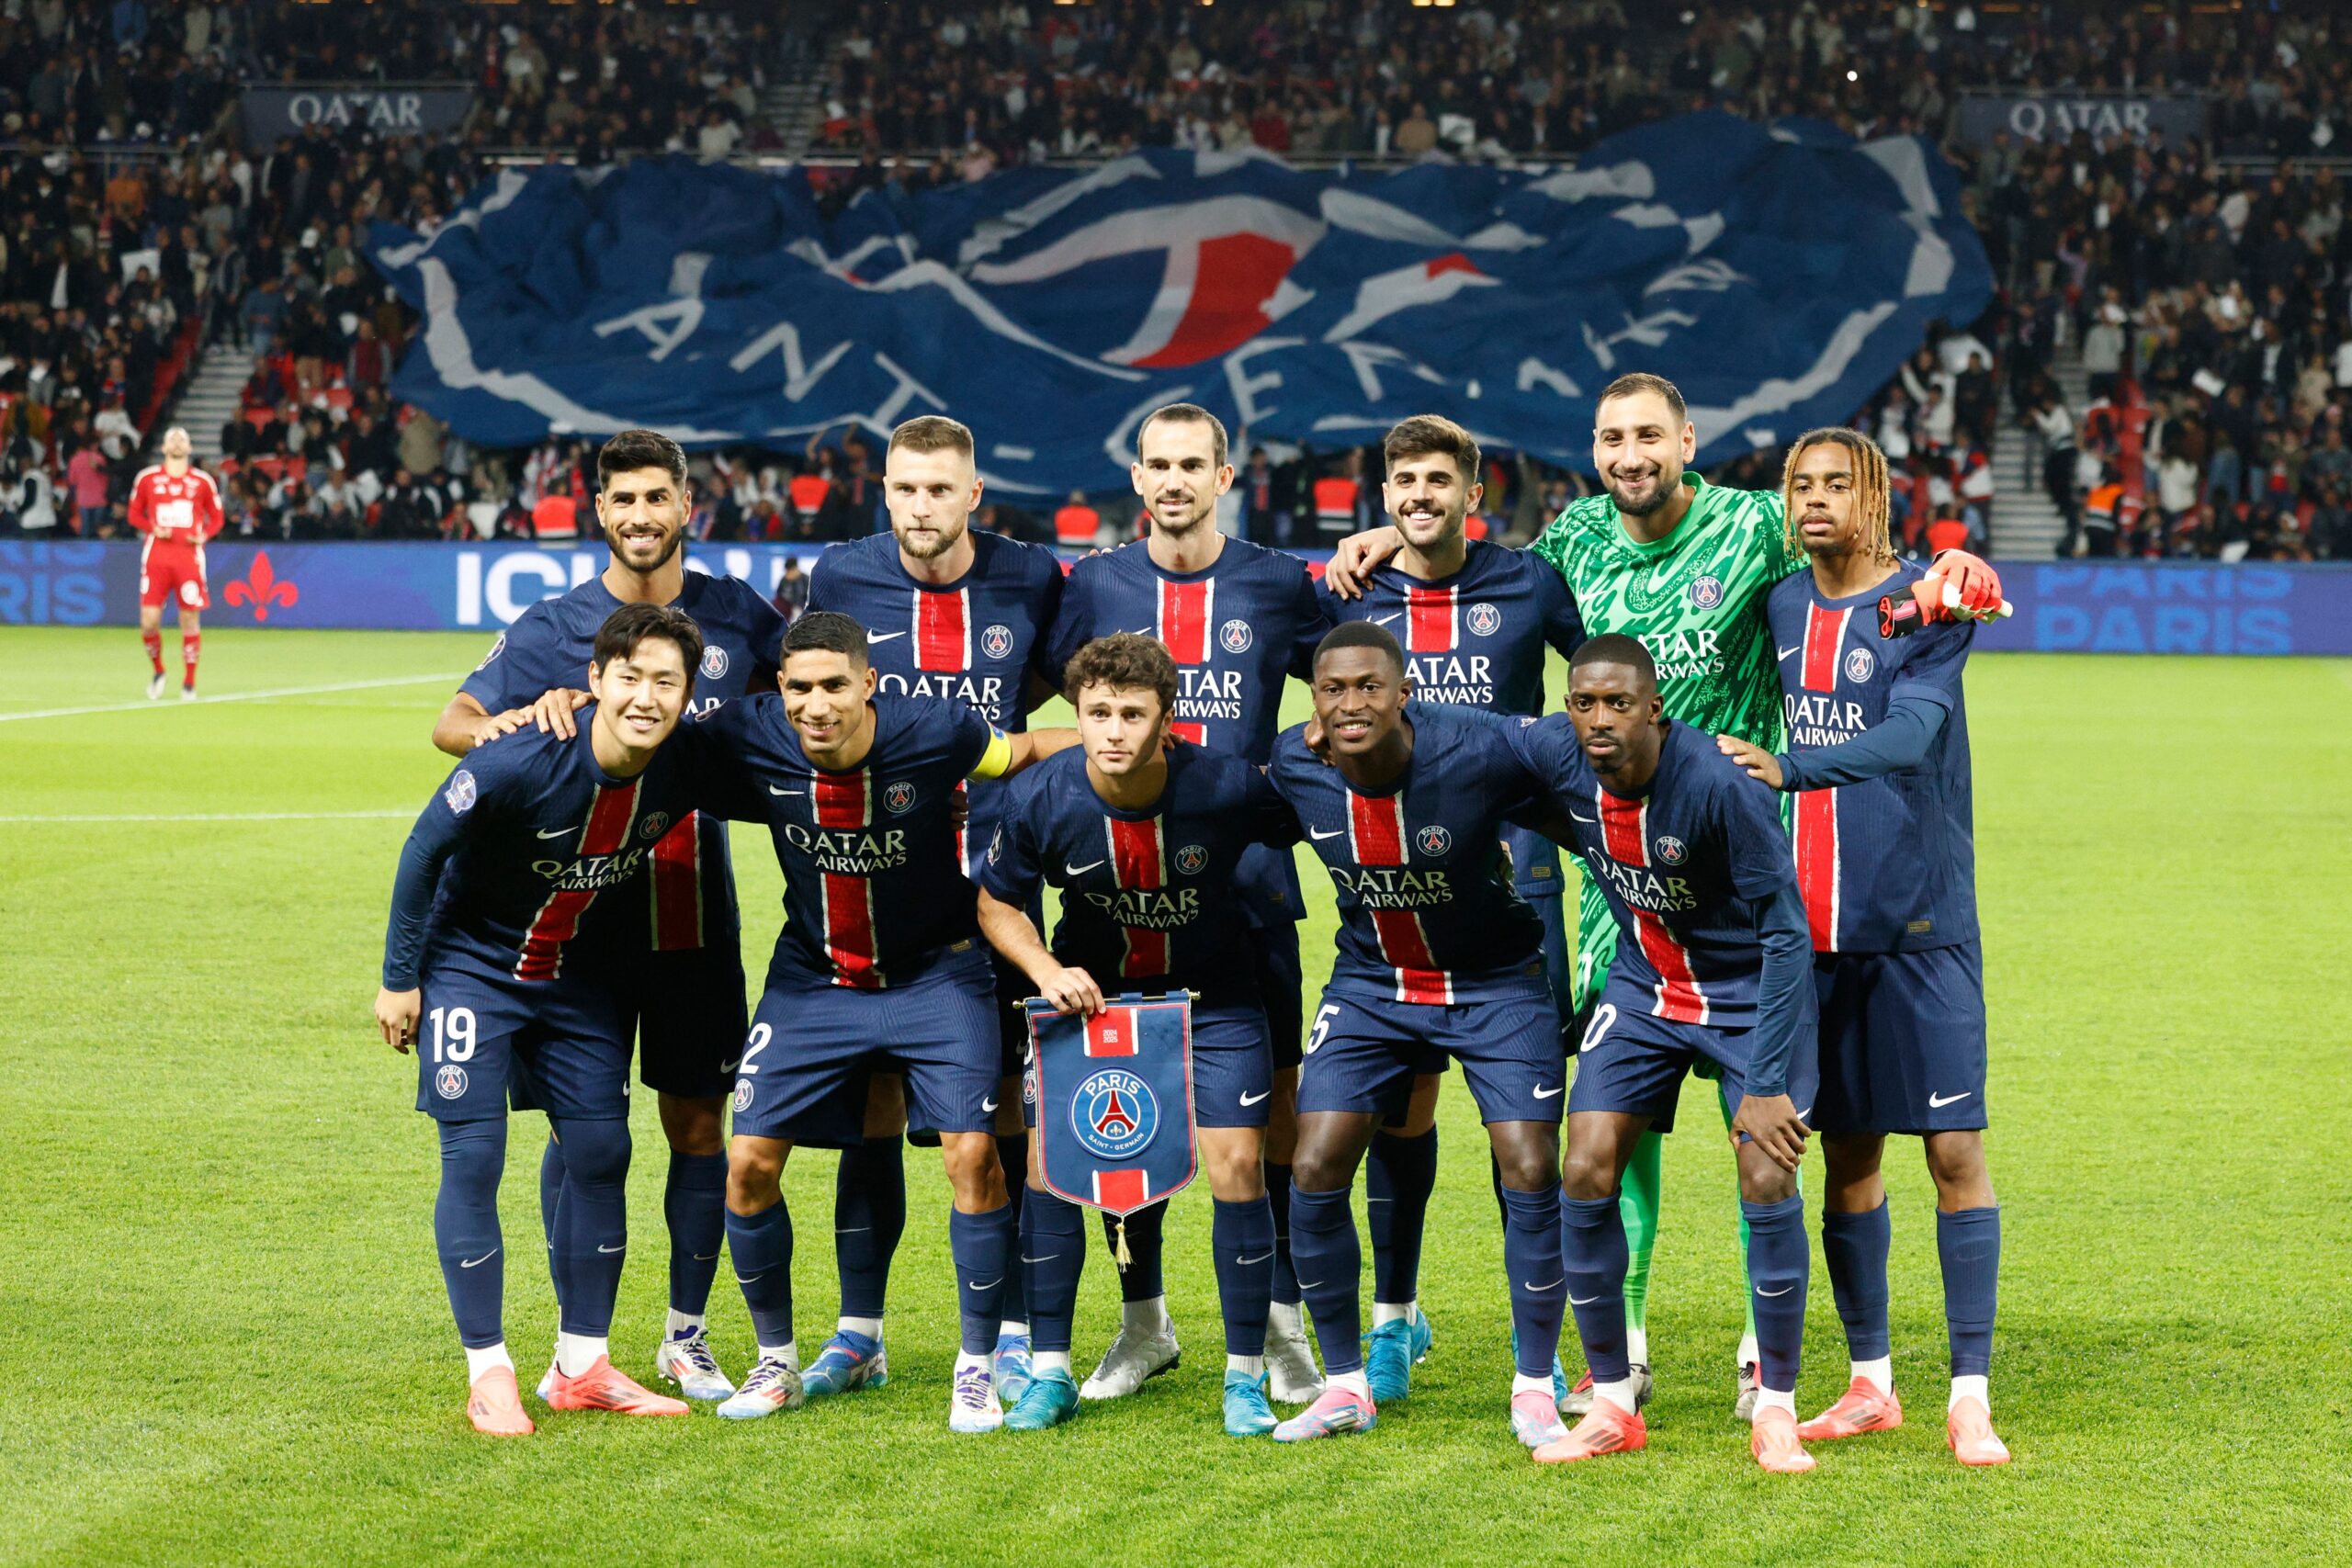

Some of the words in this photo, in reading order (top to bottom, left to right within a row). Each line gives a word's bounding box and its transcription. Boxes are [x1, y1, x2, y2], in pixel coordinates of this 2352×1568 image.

[0, 572, 105, 624] RIS
[1637, 629, 1722, 661] TAR
[2034, 606, 2294, 655] PARIS
[1404, 656, 1493, 685] ATAR
[1655, 657, 1725, 681] RWAYS
[879, 673, 1001, 704] QATAR
[1176, 669, 1242, 700] TAR
[1410, 686, 1494, 704] IRWAYS
[1172, 699, 1241, 719] IRWAYS
[1785, 694, 1868, 731] QATAR
[1792, 726, 1858, 747] AIRWA
[785, 823, 907, 854] QATAR
[1421, 827, 1443, 836] PARIS
[532, 847, 643, 879] QATAR
[815, 852, 907, 873] AIRWAYS
[1588, 846, 1692, 897] QATAR
[551, 866, 636, 889] AIRWAYS
[1329, 866, 1450, 895] QATAR
[1084, 888, 1200, 915] QATAR
[1362, 887, 1453, 908] AIRWAYS
[1615, 882, 1697, 912] AIRWAYS
[1113, 906, 1199, 929] AIRWAYS
[429, 1006, 477, 1063] 19
[739, 1022, 772, 1075] 2
[1084, 1074, 1141, 1097] PARIS
